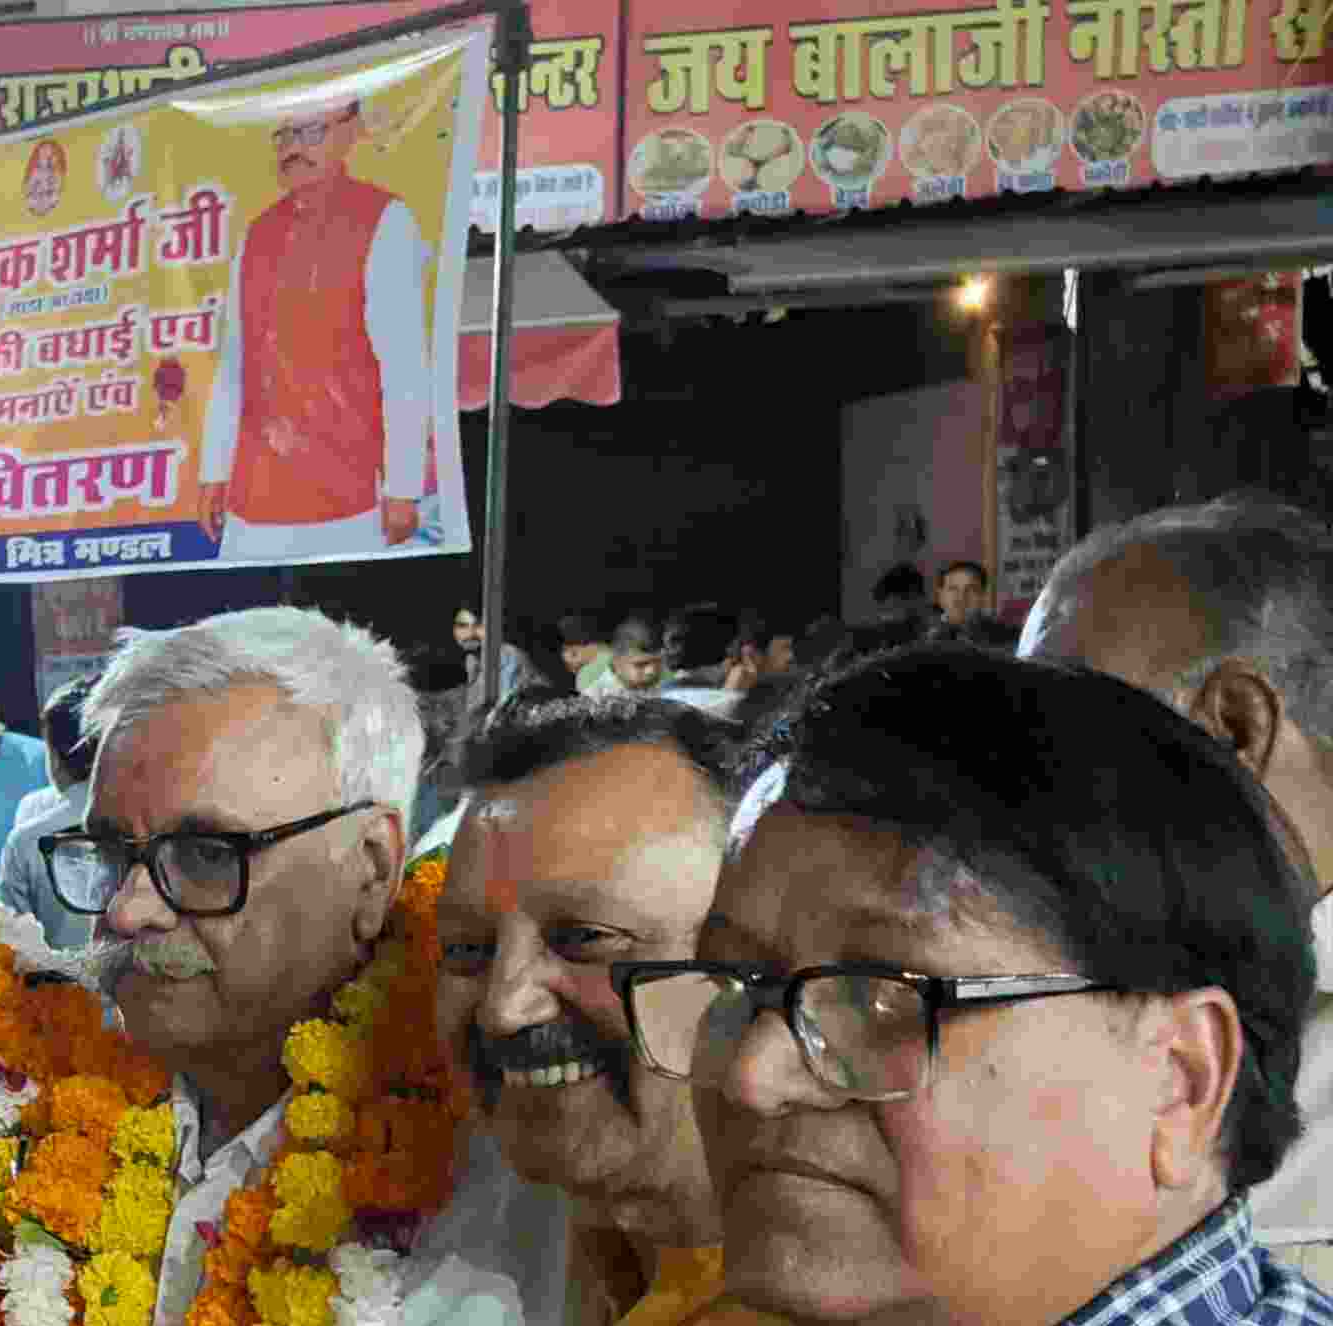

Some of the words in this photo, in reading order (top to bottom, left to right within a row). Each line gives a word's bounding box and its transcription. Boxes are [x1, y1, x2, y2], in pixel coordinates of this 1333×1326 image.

[644, 27, 774, 114] जय
[789, 0, 1052, 103] बालाजी
[51, 199, 146, 282] शर्मा
[159, 189, 226, 262] जी
[36, 310, 137, 364] बधाई
[149, 297, 216, 351] एवं
[6, 537, 64, 570] मित्र
[75, 532, 173, 562] मण्डल
